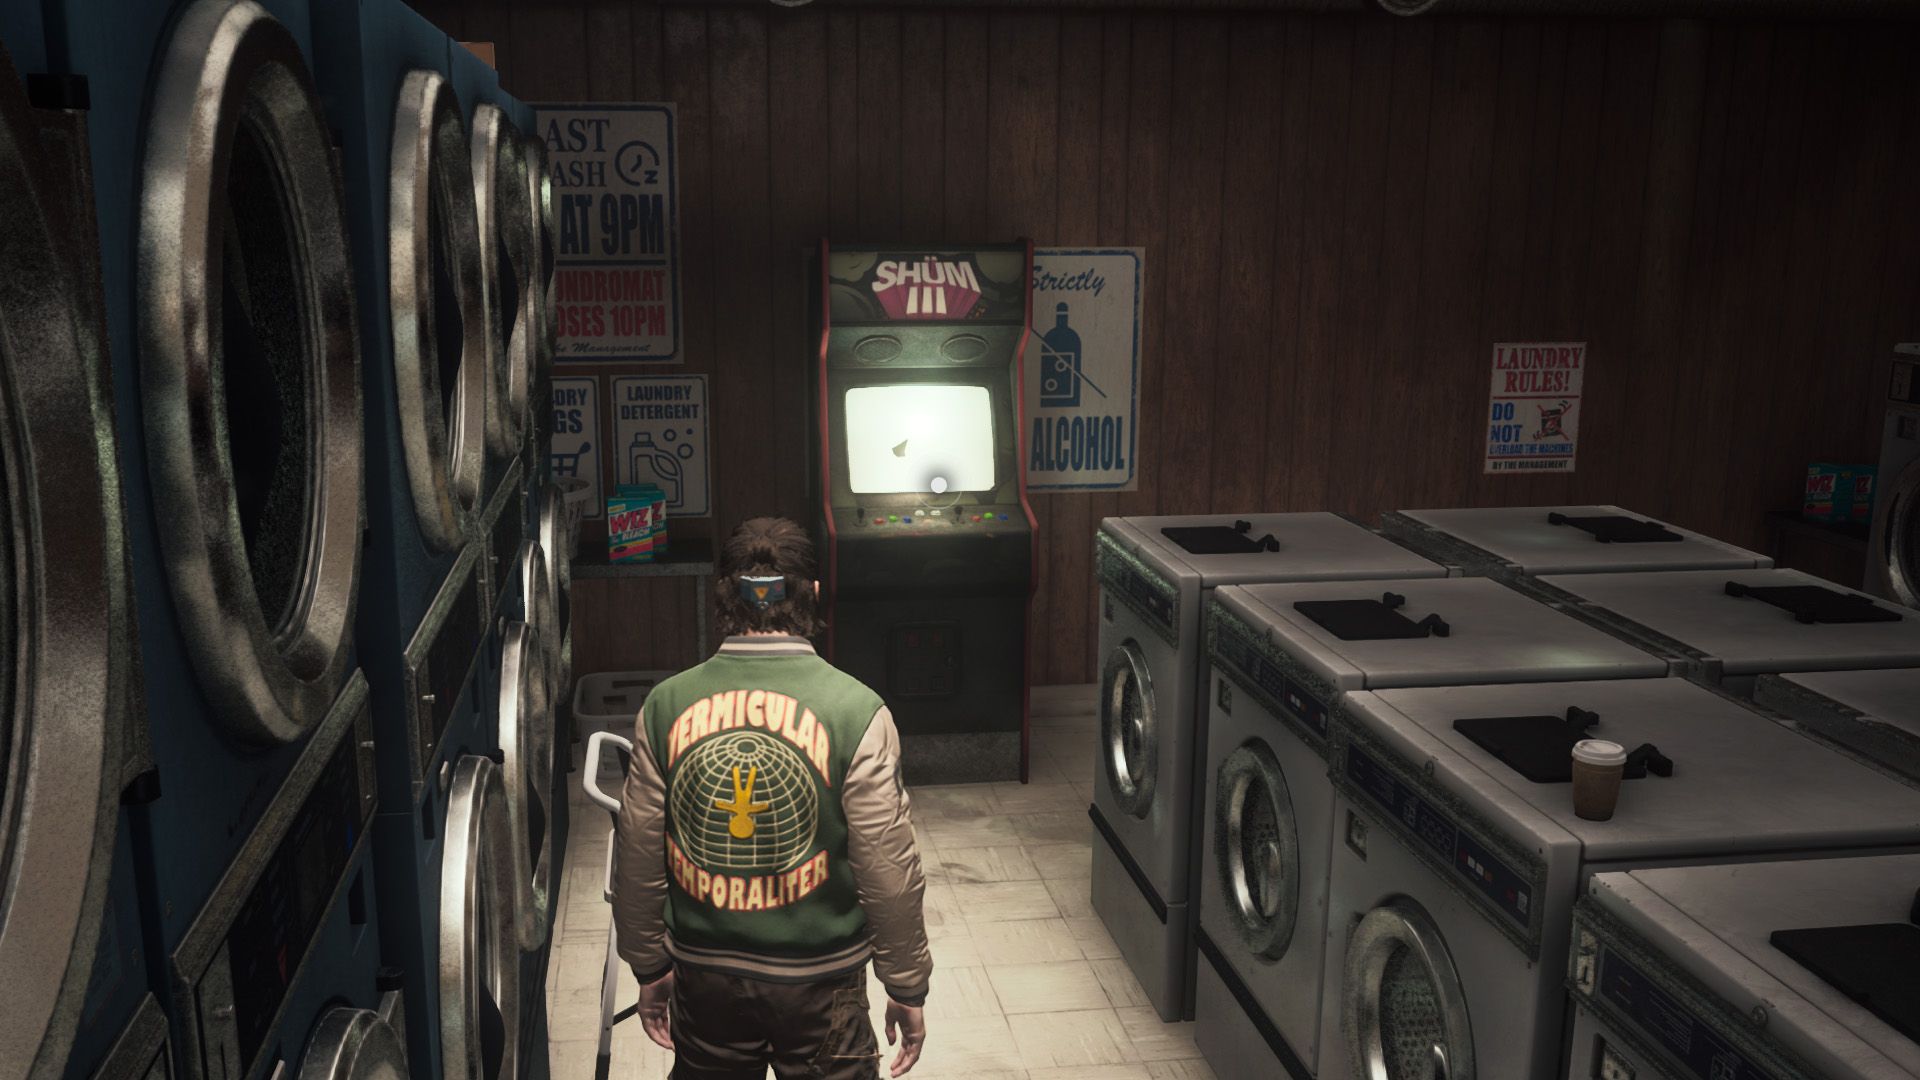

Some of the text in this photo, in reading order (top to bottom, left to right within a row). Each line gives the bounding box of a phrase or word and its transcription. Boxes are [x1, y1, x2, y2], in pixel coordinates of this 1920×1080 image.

[546, 118, 610, 152] AST
[551, 160, 608, 187] ASH
[560, 193, 664, 255] AT 9PM
[872, 256, 981, 293] SHÜM
[1032, 266, 1106, 297] Strictly
[610, 304, 665, 337] 10PM
[571, 342, 651, 354] Management
[1496, 347, 1583, 369] LAUNDRY
[627, 385, 692, 401] LAUNDRY
[1504, 370, 1570, 392] RULES!
[621, 404, 700, 420] DETERGENT
[1491, 403, 1515, 421] DO
[1030, 416, 1124, 472] ALCOHOL
[1490, 425, 1523, 442] NOT
[1519, 460, 1568, 469] MANAGEMENT
[610, 507, 649, 534] WIZ
[667, 690, 832, 788] VERMICULAR
